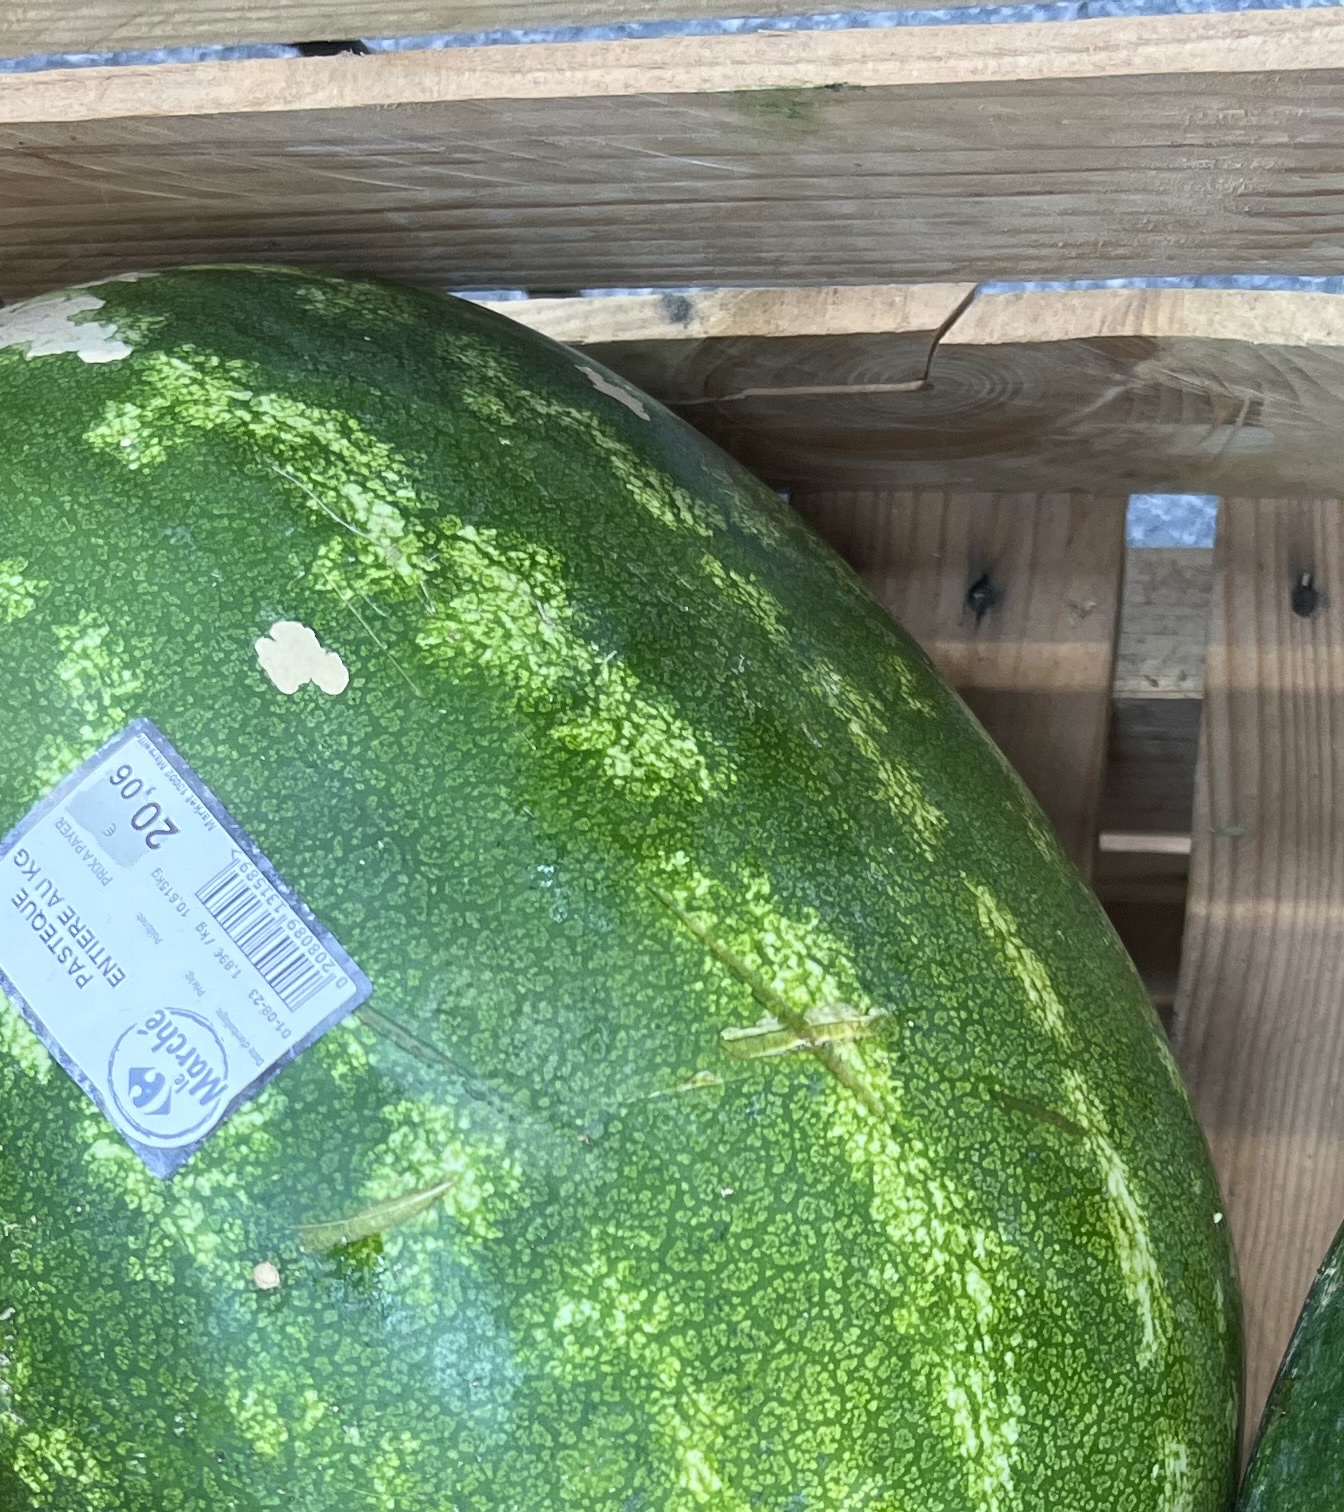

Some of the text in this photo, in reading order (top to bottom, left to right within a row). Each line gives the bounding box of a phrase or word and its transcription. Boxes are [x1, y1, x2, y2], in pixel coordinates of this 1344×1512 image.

[53, 815, 87, 855] PAYER
[108, 763, 180, 850] 20,06
[185, 793, 217, 832] Market
[86, 856, 114, 887] PRIX
[238, 856, 287, 913] 131589
[10, 886, 94, 990] PASTEQUE
[12, 847, 126, 989] ENTIERE AU KG
[285, 912, 336, 978] 208089
[136, 1007, 228, 1107] Marché
[168, 1072, 190, 1095] le
